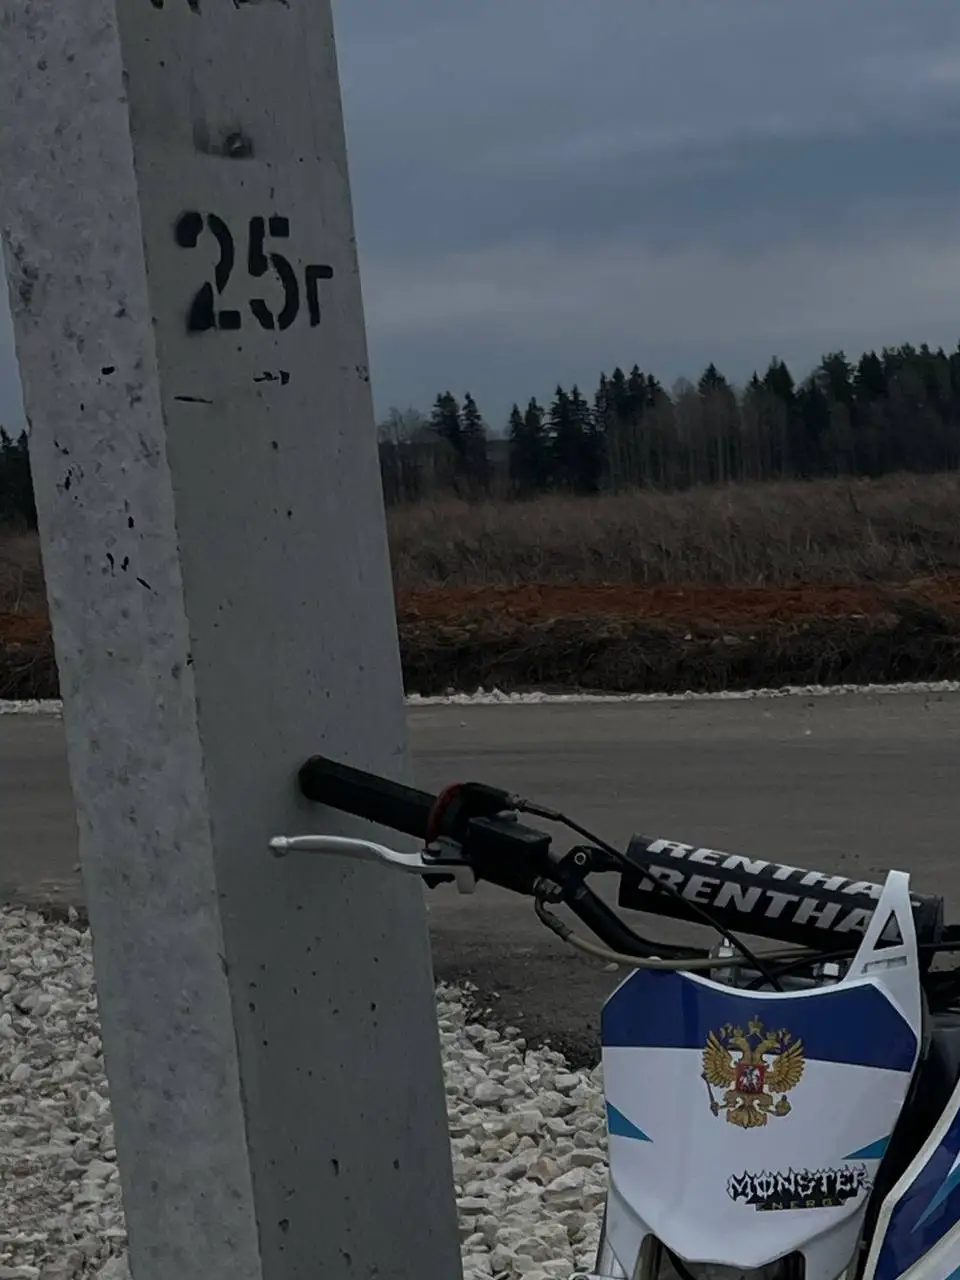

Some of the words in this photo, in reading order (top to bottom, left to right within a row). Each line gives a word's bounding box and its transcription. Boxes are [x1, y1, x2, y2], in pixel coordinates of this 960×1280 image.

[637, 864, 876, 936] RENTHA
[646, 838, 922, 907] RENTHA
[727, 1163, 874, 1201] MONSTER
